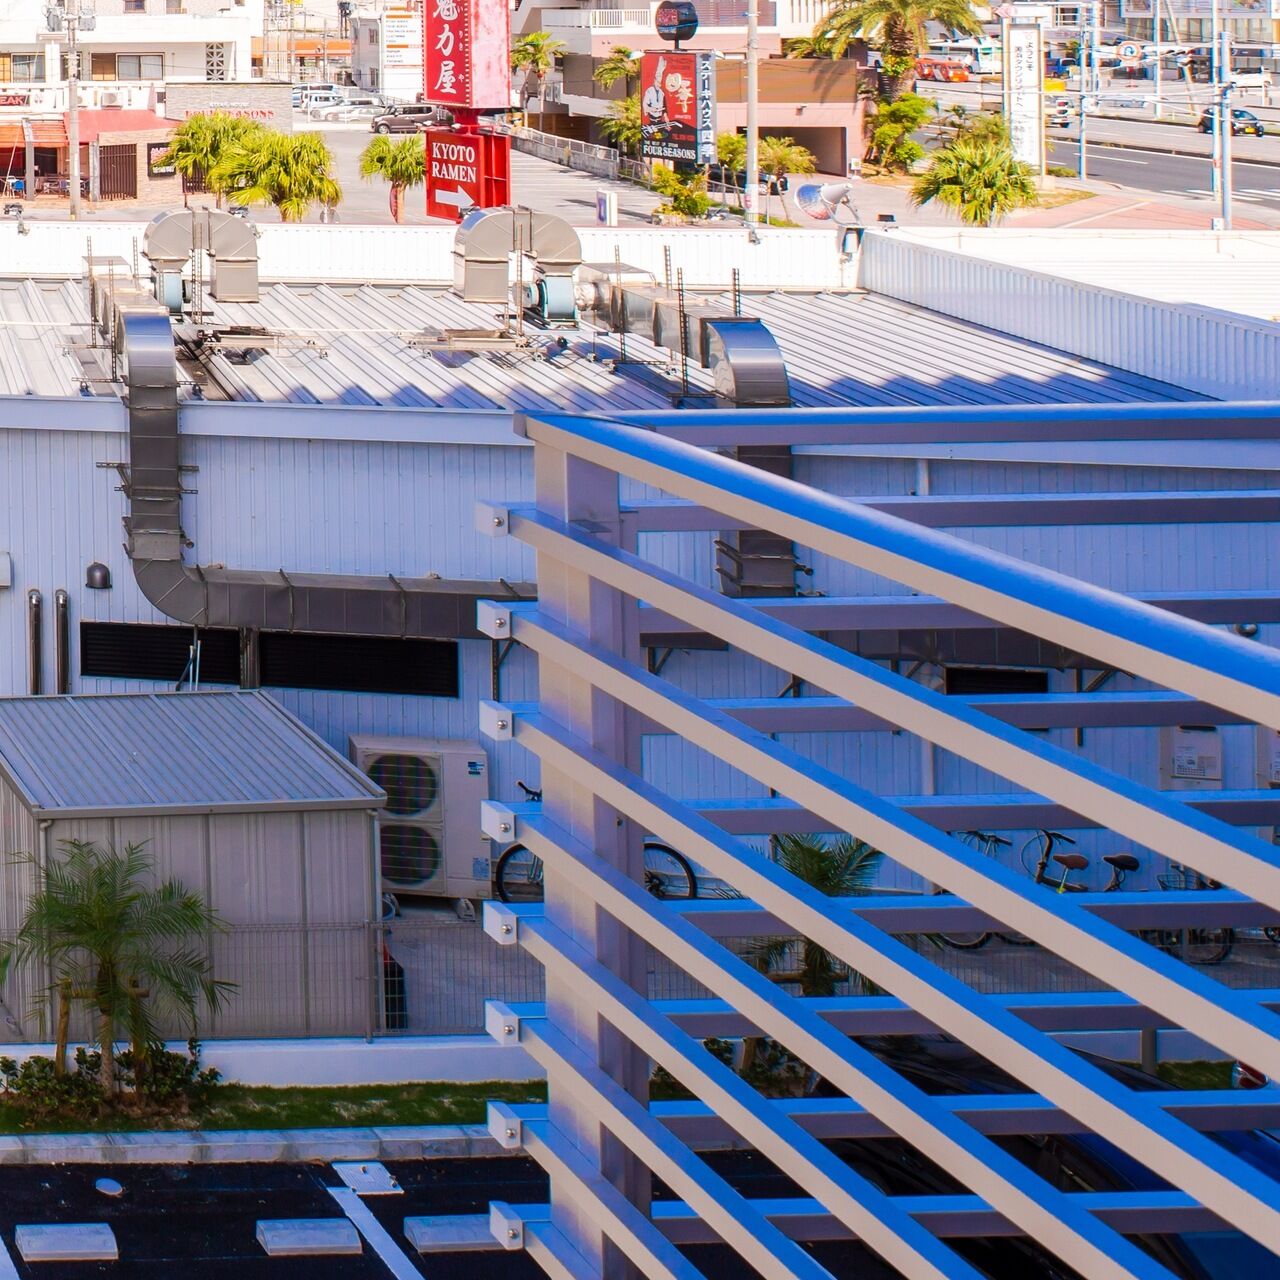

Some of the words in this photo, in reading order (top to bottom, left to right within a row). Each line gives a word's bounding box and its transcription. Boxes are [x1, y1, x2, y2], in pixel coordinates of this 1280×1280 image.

[432, 142, 475, 163] KYOTO
[643, 145, 662, 156] FOUR
[663, 147, 696, 160] SEASONS
[432, 161, 477, 183] RAMEN
